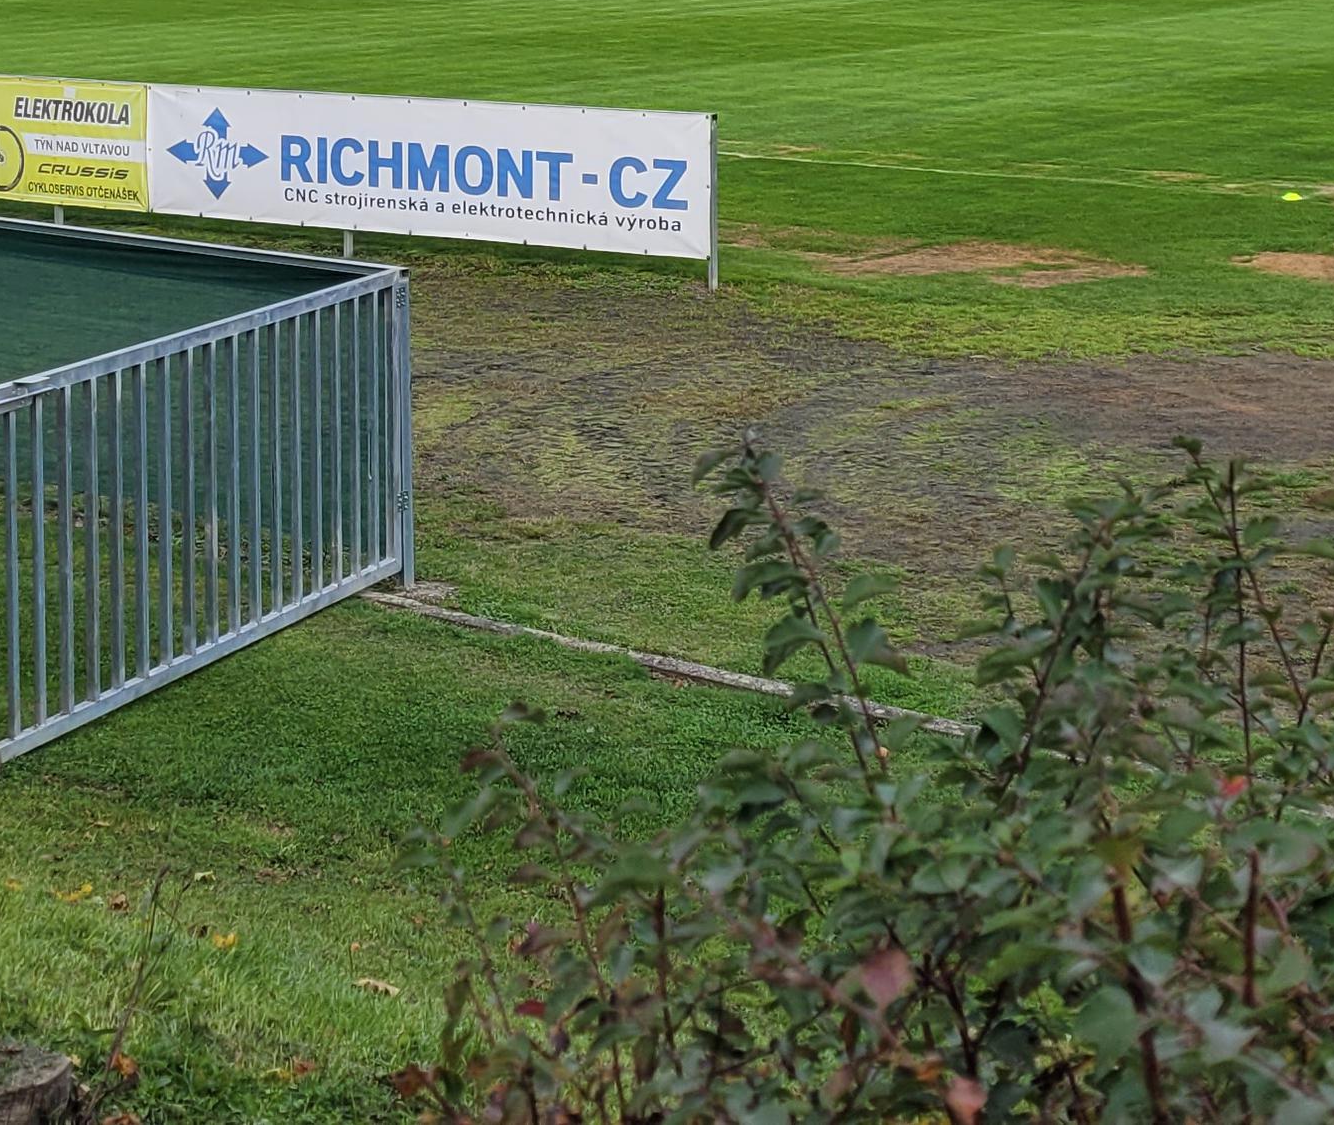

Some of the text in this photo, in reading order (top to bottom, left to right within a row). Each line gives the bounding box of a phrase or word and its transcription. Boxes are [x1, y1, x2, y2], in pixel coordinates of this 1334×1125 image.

[14, 96, 130, 125] ELEKTROKOLA
[56, 141, 79, 153] NAD
[82, 142, 130, 156] VLTAVOU
[28, 181, 139, 201] CYKLOSERVIS OTČENÁŠEK
[284, 187, 682, 233] CNC strojírenská a elektrotechnická výroba
